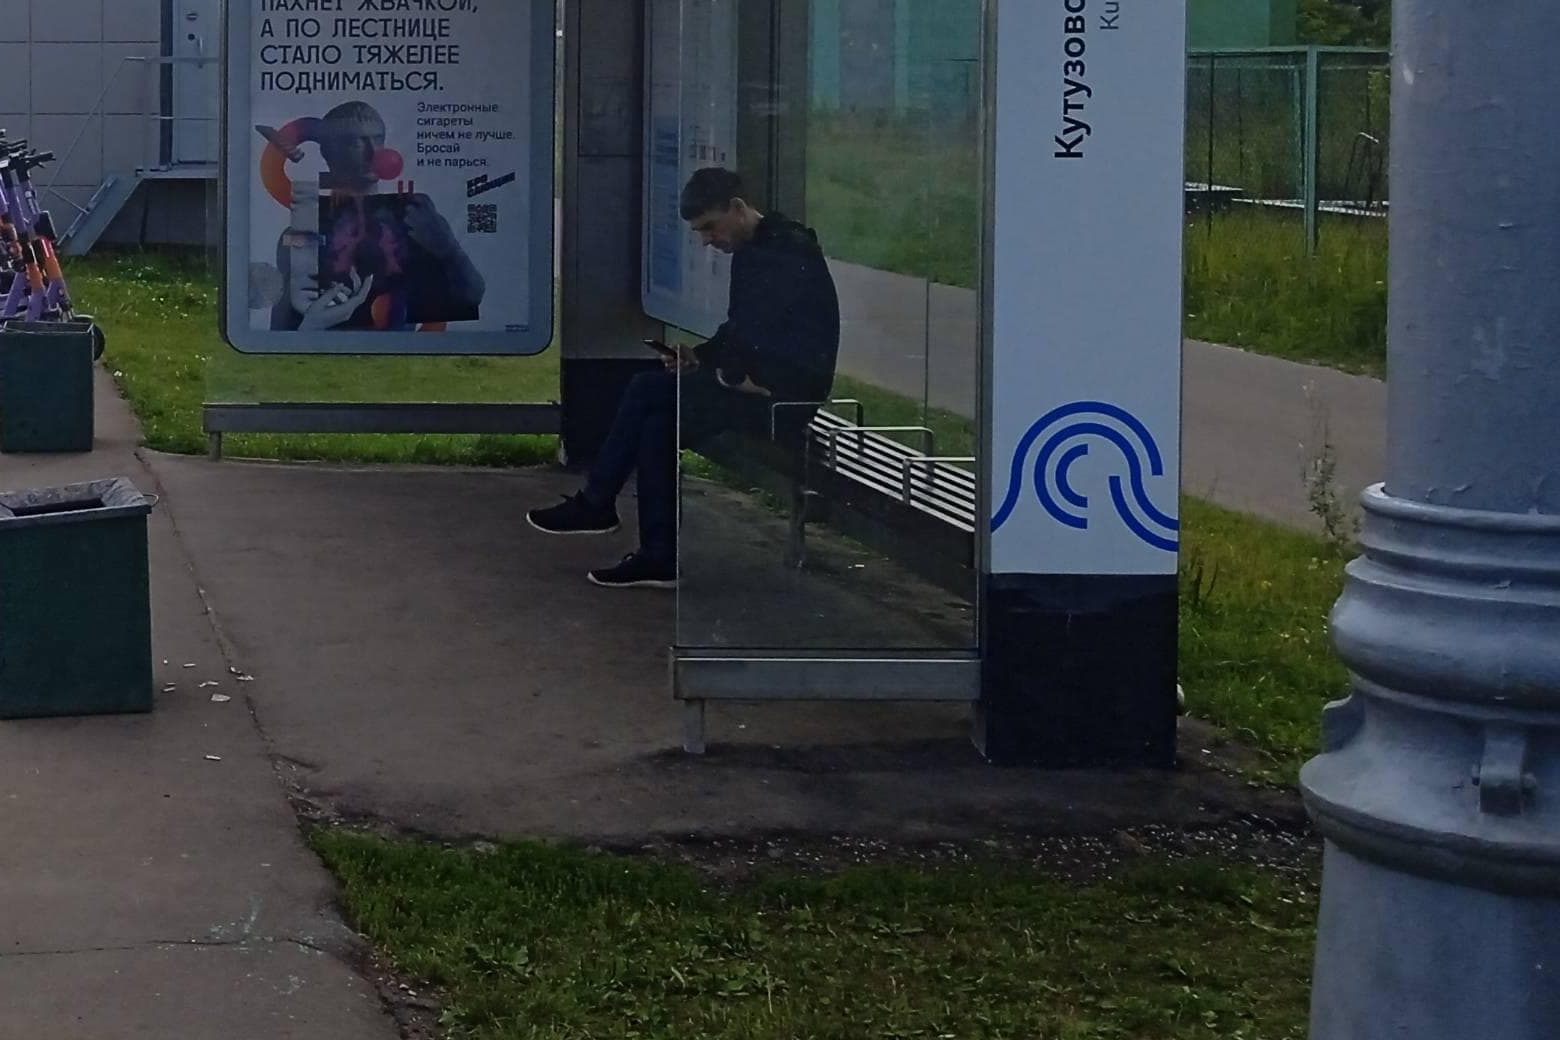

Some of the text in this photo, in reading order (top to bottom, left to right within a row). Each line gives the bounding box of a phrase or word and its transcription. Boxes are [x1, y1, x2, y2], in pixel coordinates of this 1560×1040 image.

[260, 18, 450, 42] А ПО ЛЕСТНИЦЕ
[260, 44, 460, 65] СТАЛО ТЯЖЕЛЕЕ
[260, 71, 444, 93] ПОДНИМАТЬСЯ.
[417, 102, 499, 113] Электронные
[417, 117, 473, 127] сигареты
[417, 130, 515, 142] ничем не лучше.
[417, 142, 460, 154] Бросай
[417, 158, 425, 167] и
[427, 158, 441, 167] не
